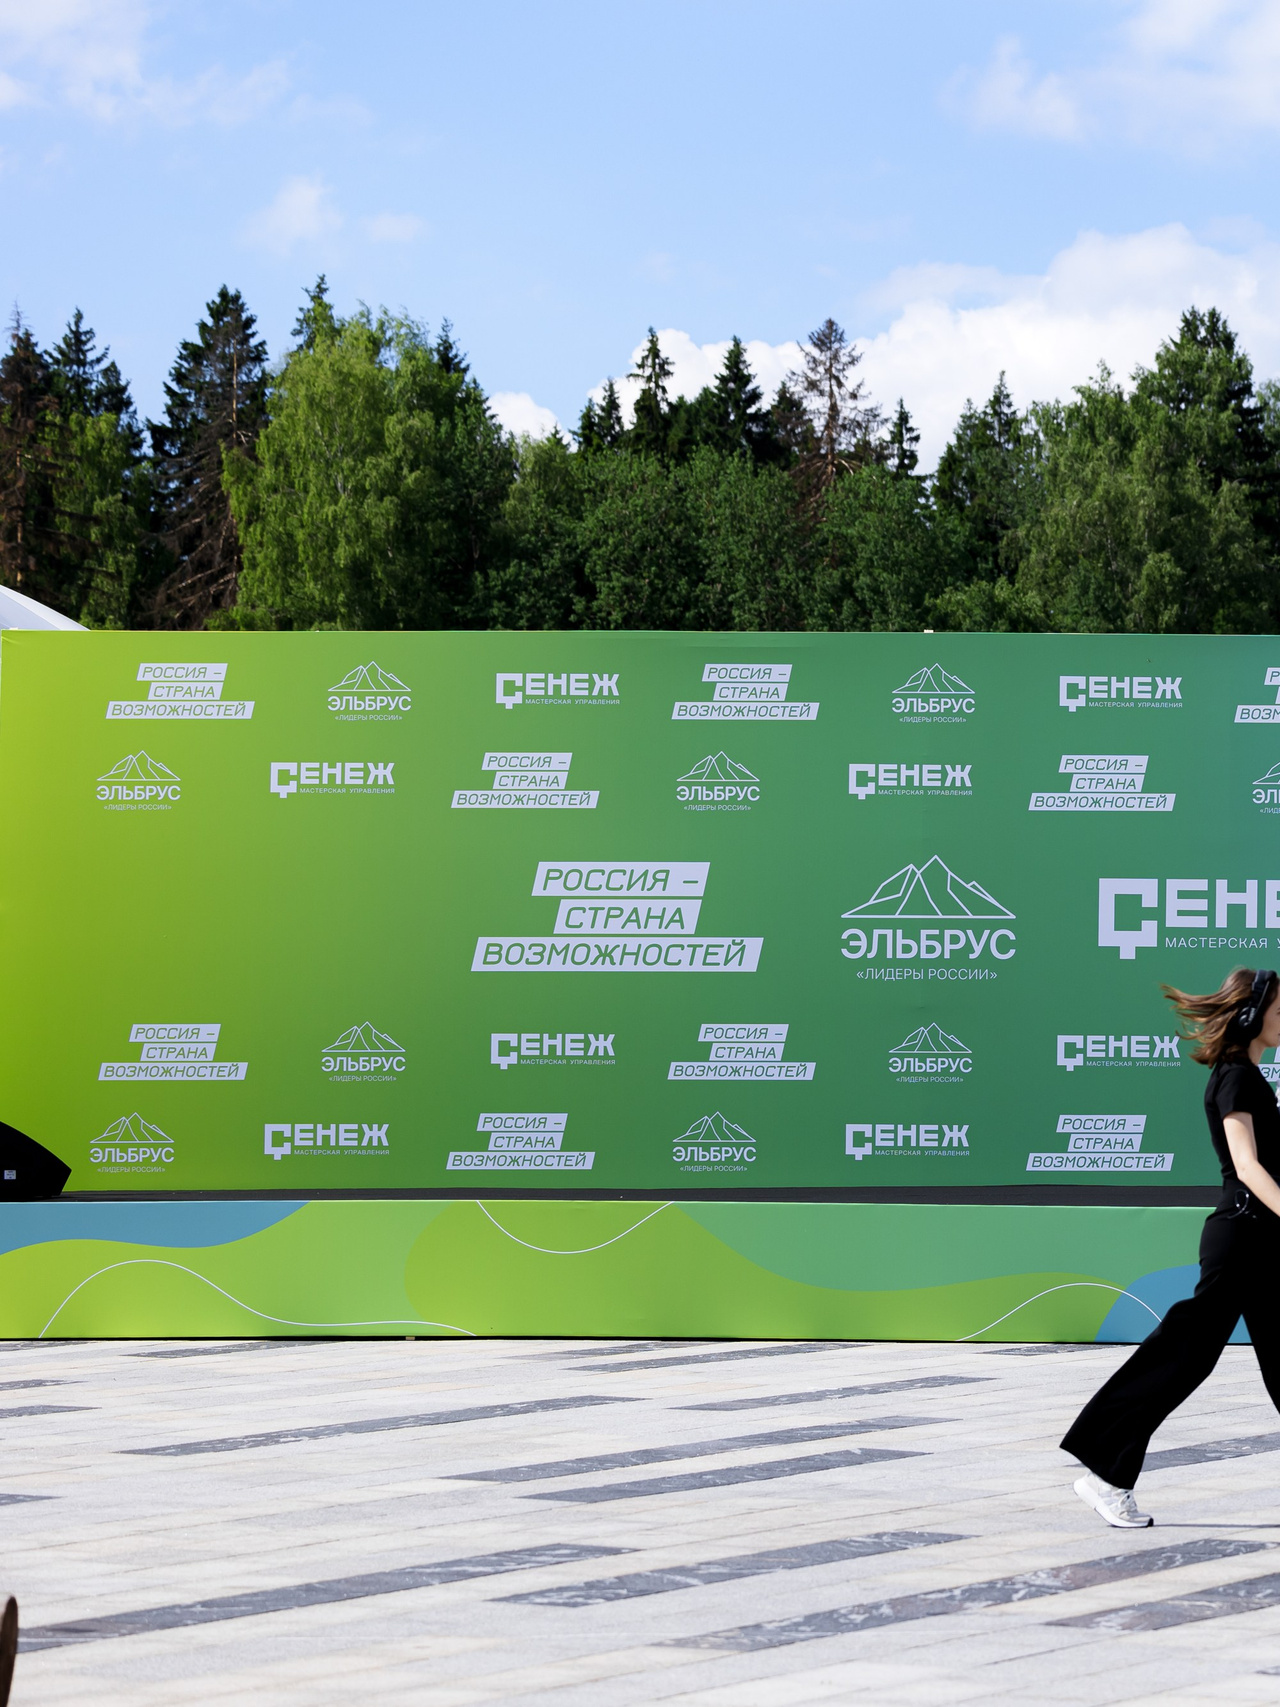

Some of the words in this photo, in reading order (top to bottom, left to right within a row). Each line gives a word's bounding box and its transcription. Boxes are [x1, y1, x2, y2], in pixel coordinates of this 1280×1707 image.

[143, 667, 207, 678] РОССИЯ
[708, 668, 772, 679] РОССИЯ
[154, 686, 214, 697] СТРАНА
[719, 687, 779, 698] СТРАНА
[328, 696, 411, 711] ЭЛЬБРУС
[892, 698, 975, 713] ЭЛЬБРУС
[112, 703, 245, 716] ВОЗМОЖНОСТЕЙ
[678, 704, 810, 717] ВОЗМОЖНОСТЕЙ
[335, 714, 370, 722] «ЛИДЕРЫ
[369, 714, 402, 722] РОССИИ»
[900, 716, 934, 724] «ЛИДЕРЫ
[488, 756, 552, 767] РОССИЯ
[1064, 759, 1128, 770] РОССИЯ
[499, 775, 559, 787] СТРАНА
[1076, 778, 1136, 789] СТРАНА
[96, 785, 181, 800] ЭЛЬБРУС
[677, 786, 760, 801] ЭЛЬБРУС
[457, 792, 590, 805] ВОЗМОЖНОСТЕЙ
[1035, 795, 1167, 808] ВОЗМОЖНОСТЕЙ
[104, 804, 139, 812] «ЛИДЕРЫ
[138, 803, 172, 811] РОССИИ»
[684, 804, 719, 812] «ЛИДЕРЫ
[718, 804, 751, 812] РОССИИ»
[543, 869, 670, 891] РОССИЯ
[565, 907, 684, 929] СТРАНА
[841, 929, 1016, 959] ЭЛЬБРУС
[1166, 938, 1267, 948] МАСТЕРСКАЯ
[483, 939, 746, 966] ВОЗМОЖНОСТЕЙ
[856, 967, 925, 984] «ЛИДЕРЫ
[928, 967, 998, 982] РОССИИ»
[135, 1028, 200, 1039] РОССИЯ
[704, 1028, 768, 1039] РОССИЯ
[147, 1047, 207, 1058] СТРАНА
[715, 1047, 776, 1058] СТРАНА
[322, 1057, 405, 1071] ЭЛЬБРУС
[889, 1058, 972, 1072] ЭЛЬБРУС
[1136, 1059, 1181, 1067] УПРАВЛЕНИЯ
[105, 1064, 238, 1077] ВОЗМОЖНОСТЕЙ
[674, 1064, 807, 1077] ВОЗМОЖНОСТЕЙ
[329, 1075, 364, 1083] «ЛИДЕРЫ
[363, 1074, 397, 1082] РОССИИ»
[896, 1076, 931, 1084] «ЛИДЕРЫ
[930, 1075, 963, 1083] РОССИИ»
[483, 1117, 547, 1128] РОССИЯ
[1062, 1118, 1126, 1130] РОССИЯ
[494, 1136, 555, 1148] СТРАНА
[1073, 1138, 1134, 1149] СТРАНА
[90, 1147, 174, 1163] ЭЛЬБРУС
[294, 1148, 340, 1156] МАСТЕРСКАЯ
[344, 1148, 389, 1156] УПРАВЛЕНИЯ
[673, 1147, 756, 1161] ЭЛЬБРУС
[925, 1149, 969, 1157] УПРАВЛЕНИЯ
[452, 1153, 586, 1166] ВОЗМОЖНОСТЕЙ
[1032, 1155, 1165, 1168] ВОЗМОЖНОСТЕЙ
[97, 1166, 132, 1174] «ЛИДЕРЫ
[130, 1166, 165, 1174] РОССИИ»
[680, 1165, 715, 1173] «ЛИДЕРЫ
[714, 1164, 747, 1172] РОССИИ»
